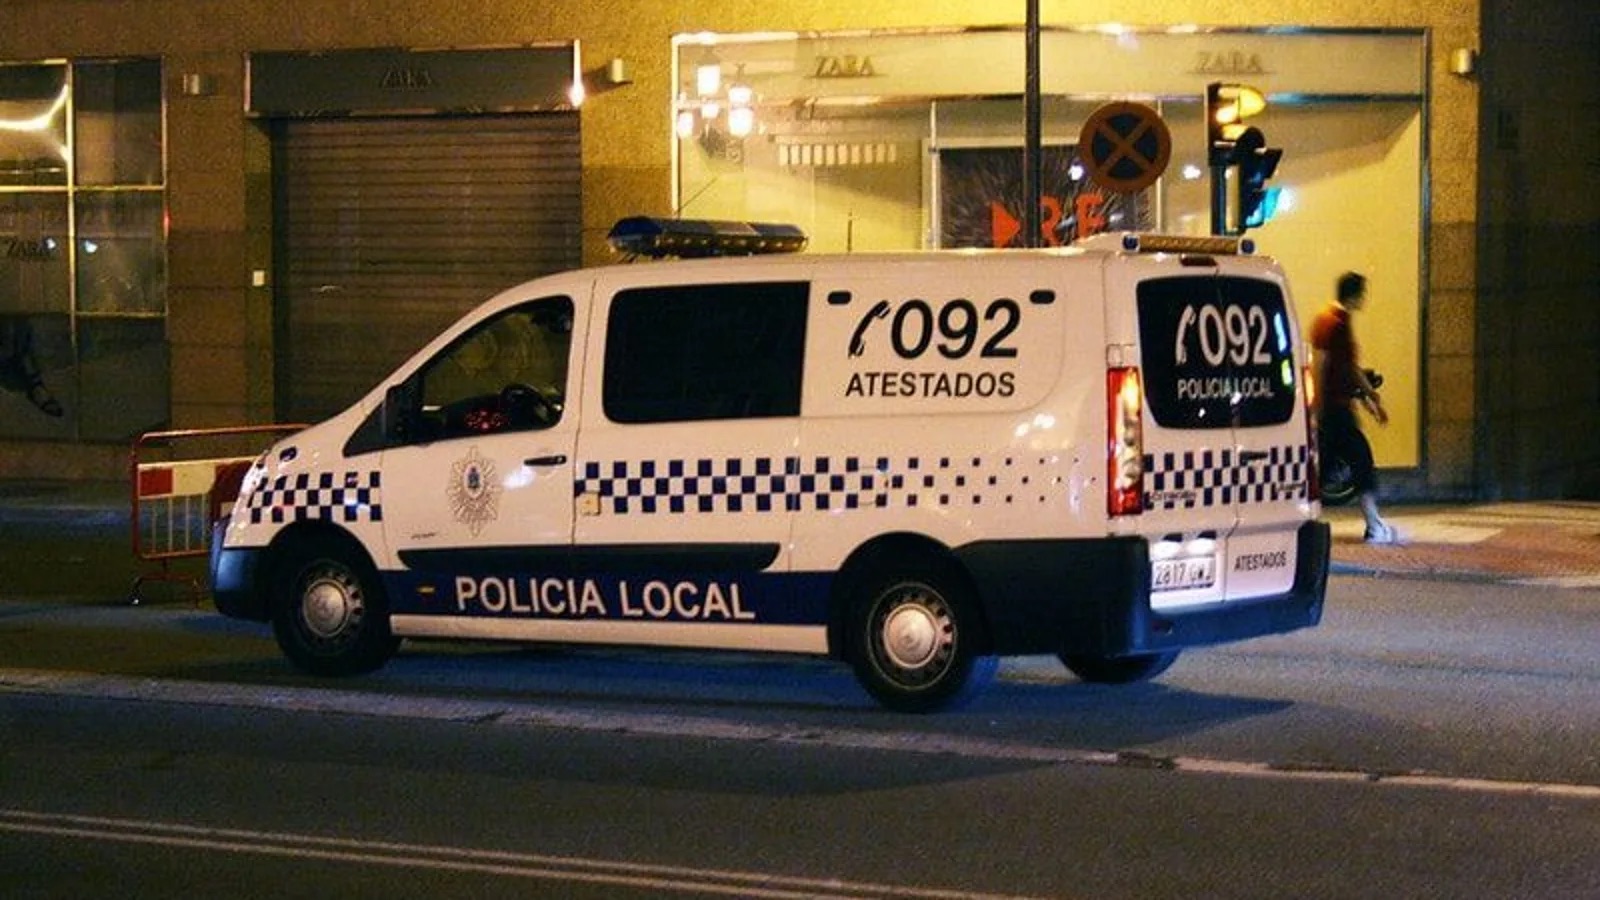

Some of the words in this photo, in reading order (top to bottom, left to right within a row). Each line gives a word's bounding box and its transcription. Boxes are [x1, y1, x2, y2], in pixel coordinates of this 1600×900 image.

[814, 55, 876, 78] ZARA
[1195, 50, 1265, 76] ZARA
[891, 298, 1021, 359] 092
[1198, 304, 1272, 366] 092
[845, 371, 1016, 397] ATESTADOS
[1176, 377, 1231, 399] POLICIA
[1232, 377, 1275, 399] LOCAL
[1233, 551, 1287, 571] ATESTADOS
[454, 575, 607, 616] POLICIA
[618, 580, 756, 619] LOCAL
